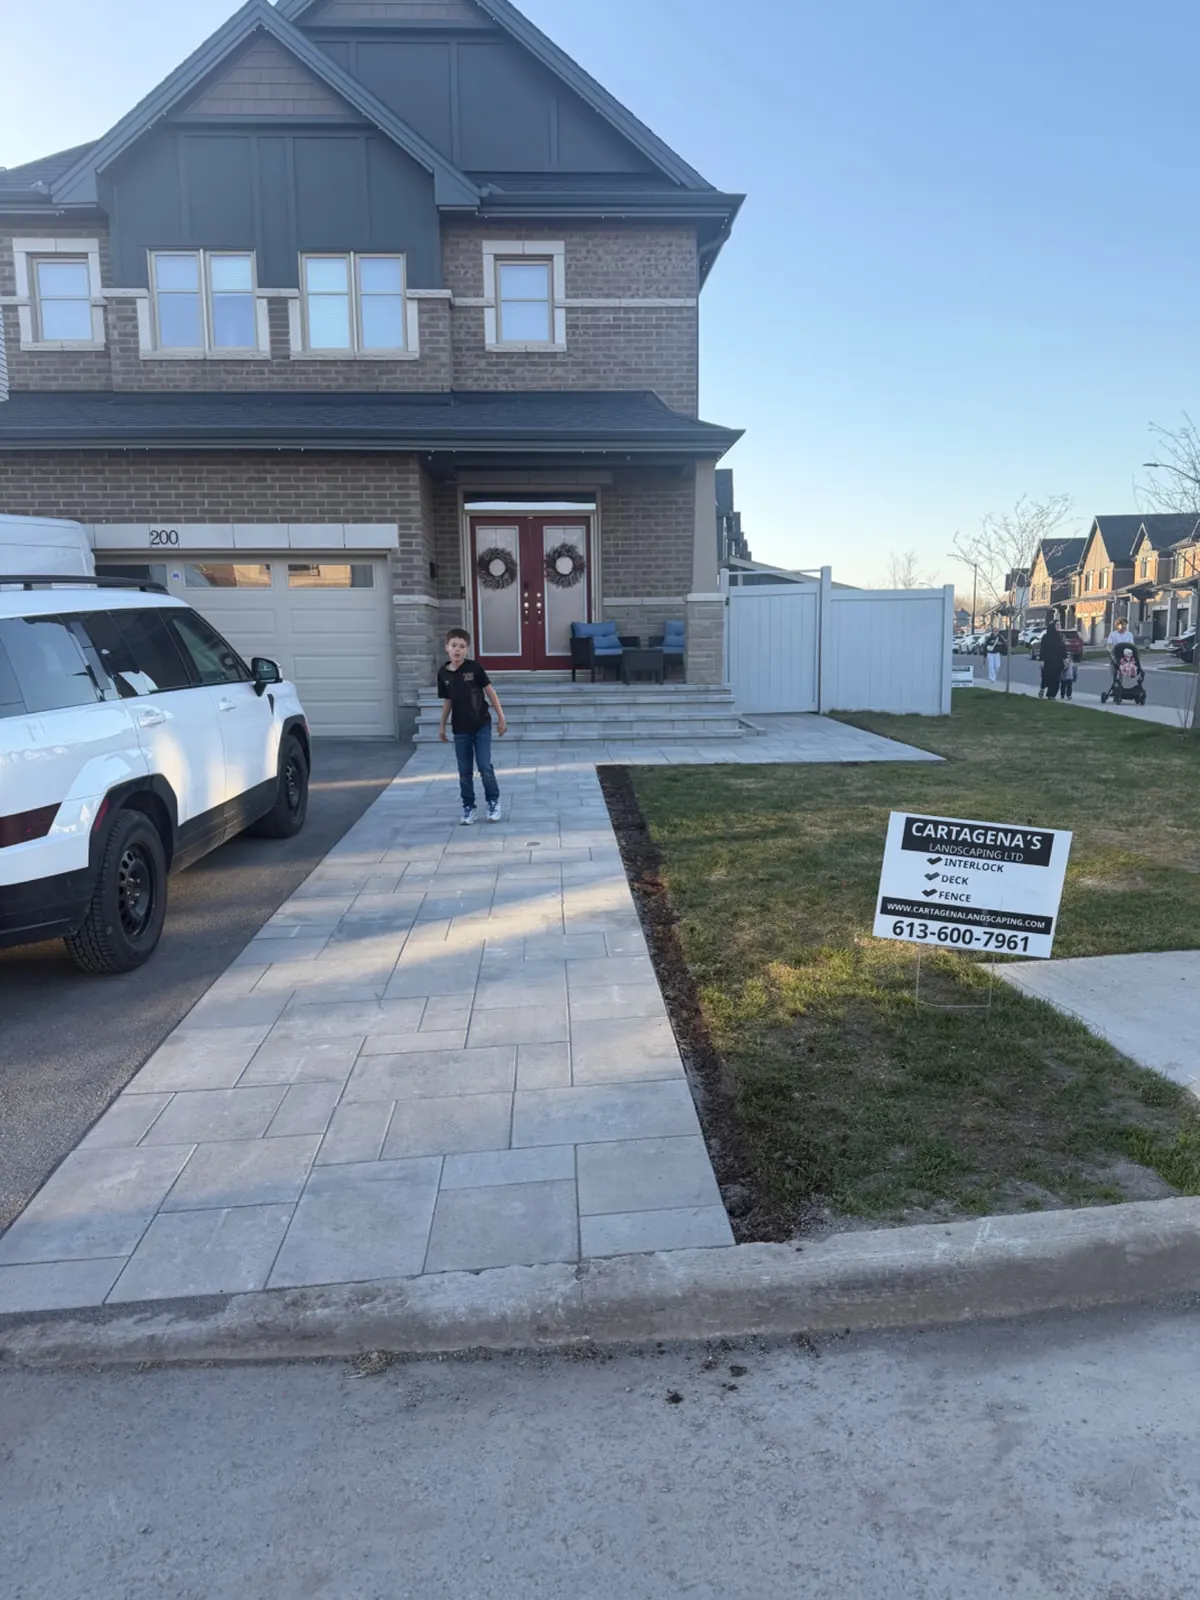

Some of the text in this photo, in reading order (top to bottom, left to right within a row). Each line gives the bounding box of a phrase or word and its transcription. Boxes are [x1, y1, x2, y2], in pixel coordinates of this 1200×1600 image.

[150, 529, 179, 545] 200
[911, 822, 1042, 850] CARTAGENA'S
[928, 843, 1024, 861] LANDSCAPING LTD
[944, 858, 1004, 873] INTERLOCK
[941, 874, 969, 886] DECK
[938, 890, 971, 903] FENCE
[886, 902, 1046, 929] WWW.CARTAGENALANDSCAPING.COM
[892, 920, 1030, 952] 613-600-7961
